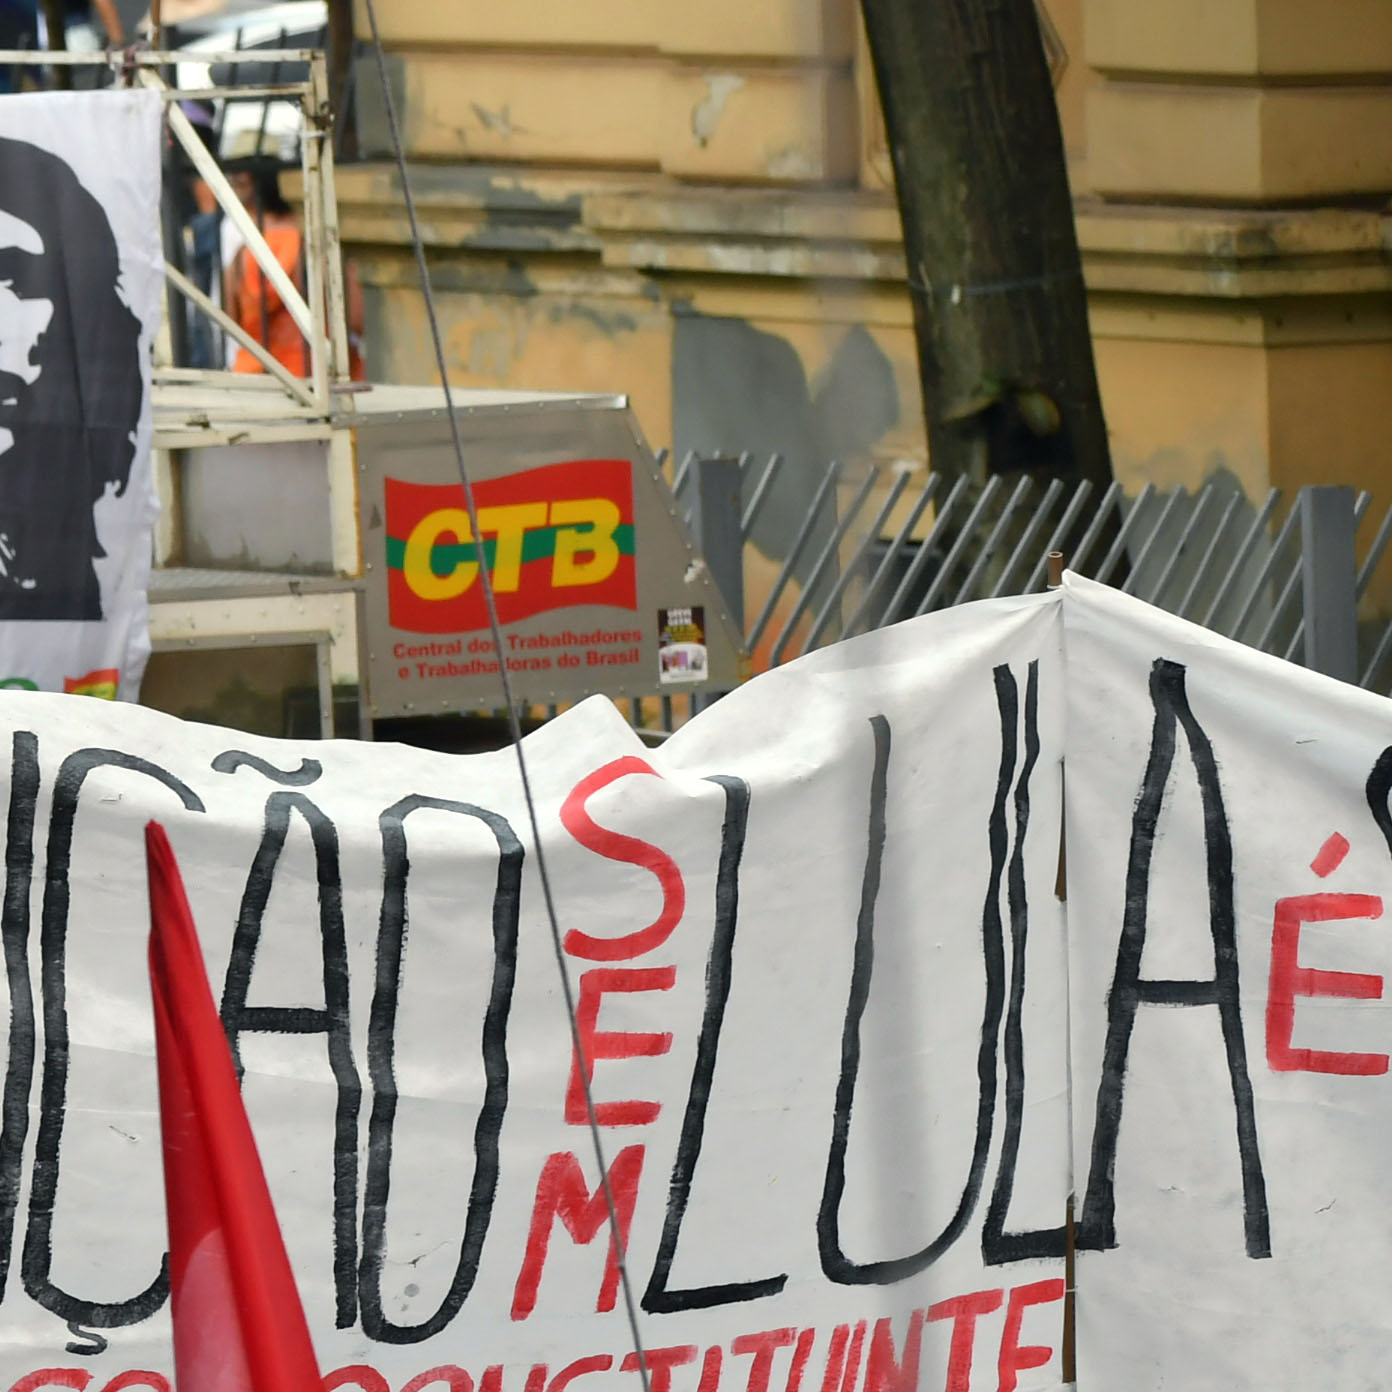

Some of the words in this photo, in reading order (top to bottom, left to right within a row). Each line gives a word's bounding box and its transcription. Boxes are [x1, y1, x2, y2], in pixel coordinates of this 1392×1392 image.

[403, 497, 621, 602] CTB
[393, 640, 462, 660] Central
[507, 627, 643, 651] Trabalhadores
[398, 666, 410, 679] e
[557, 653, 580, 668] do
[586, 647, 640, 667] Brasil
[510, 754, 685, 1322] SEM
[641, 656, 1272, 1314] LULA
[1265, 832, 1391, 1077] É
